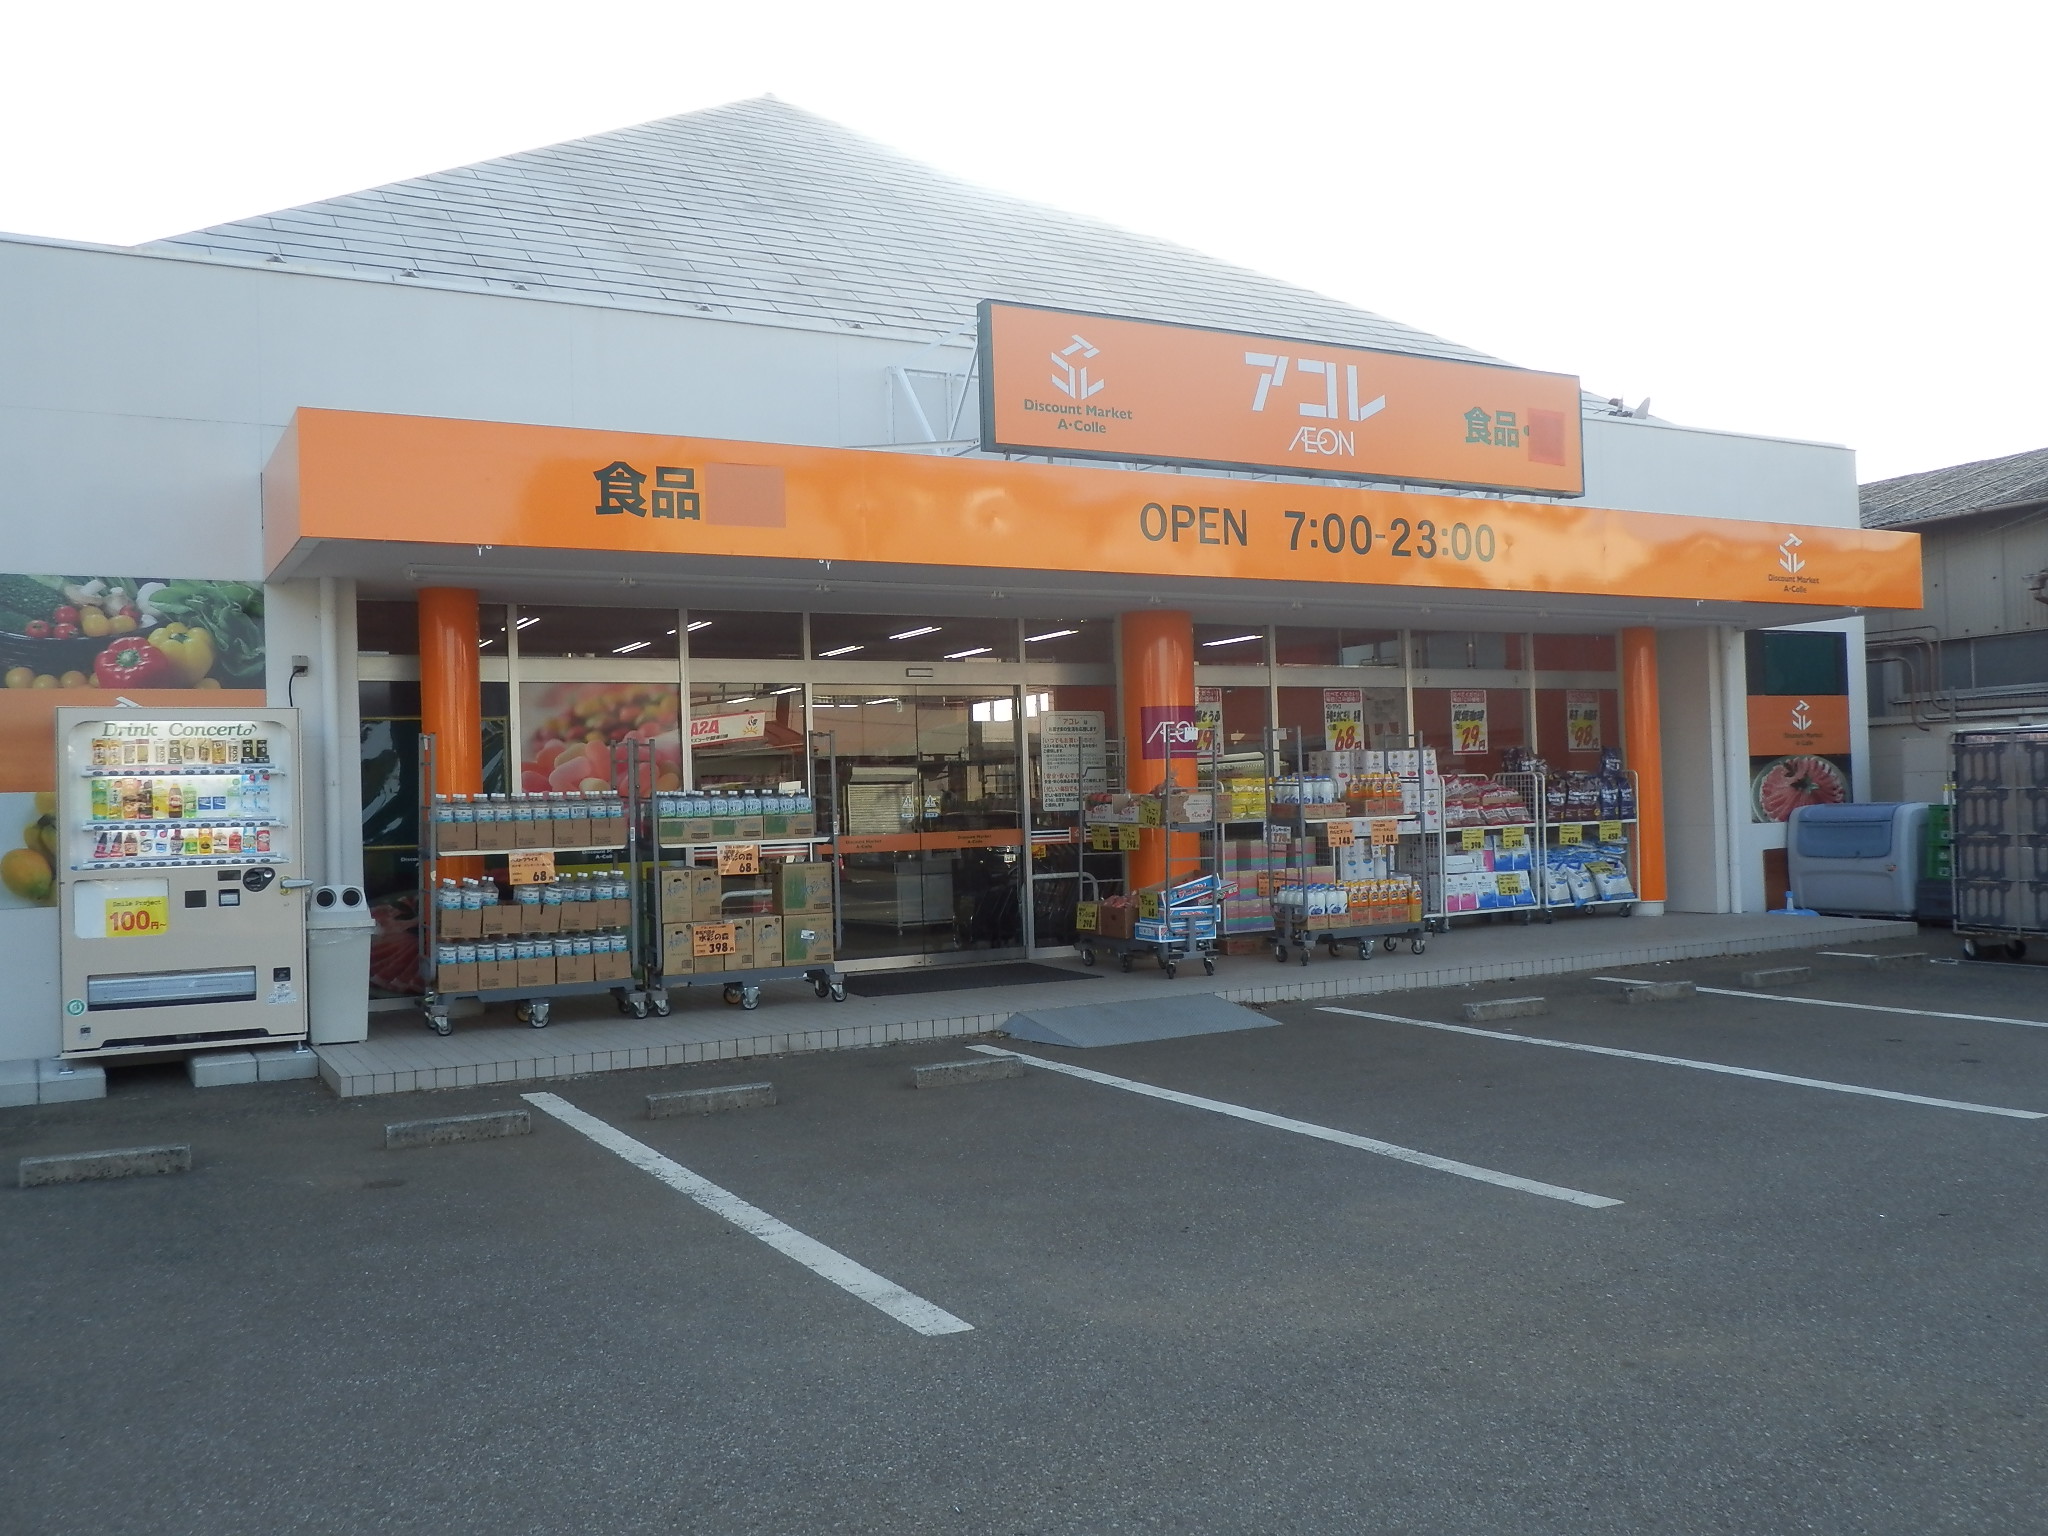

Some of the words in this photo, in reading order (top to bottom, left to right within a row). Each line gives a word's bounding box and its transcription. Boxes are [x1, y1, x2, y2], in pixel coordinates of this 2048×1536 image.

[1245, 352, 1386, 421] アコレ
[1024, 399, 1082, 415] Discount
[1085, 406, 1133, 420] Market
[593, 461, 701, 520] 食品
[1140, 502, 1248, 546] OPEN
[1284, 510, 1496, 562] 7:00-23:00
[1768, 574, 1796, 583] Discount
[1796, 576, 1820, 584] Market
[102, 723, 158, 737] Drink
[168, 722, 257, 737] Concerto
